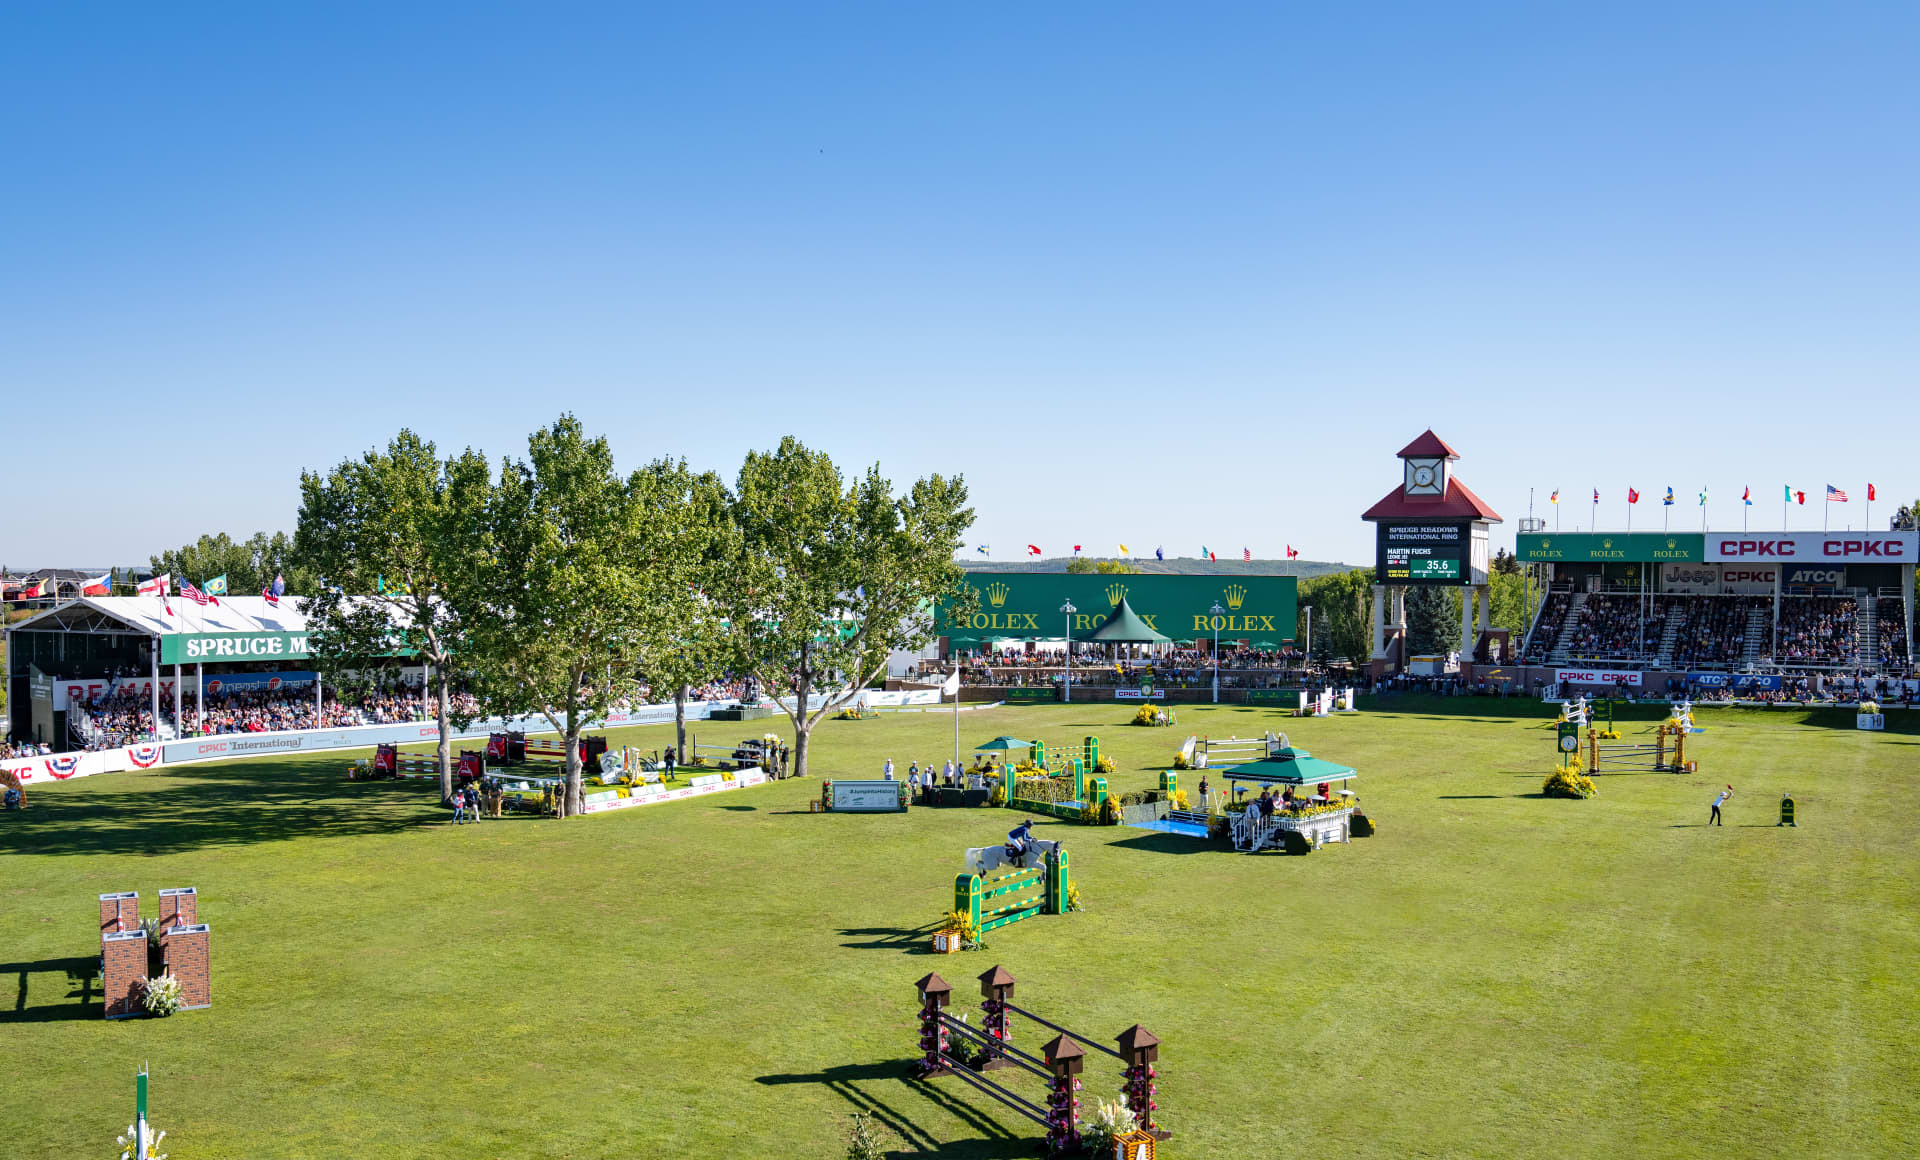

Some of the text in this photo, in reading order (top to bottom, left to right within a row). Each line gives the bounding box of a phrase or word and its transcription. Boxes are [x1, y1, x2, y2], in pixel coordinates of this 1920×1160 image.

[1529, 550, 1562, 558] ROLEX
[1590, 550, 1624, 558] ROLEX
[1653, 550, 1689, 558] ROLEX
[1720, 541, 1903, 556] CPKC CPKC
[1427, 560, 1448, 570] 35.6
[1666, 567, 1716, 586] Jeep
[1724, 571, 1775, 583] CPKC
[1790, 571, 1837, 583] ATCO
[1073, 614, 1159, 631] ROX
[1193, 615, 1276, 632] ROLEX
[187, 636, 282, 657] SPRUCE
[1560, 672, 1595, 681] CPKC
[419, 728, 441, 737] CPK
[198, 736, 304, 754] CPKC International
[935, 936, 947, 952] 16
